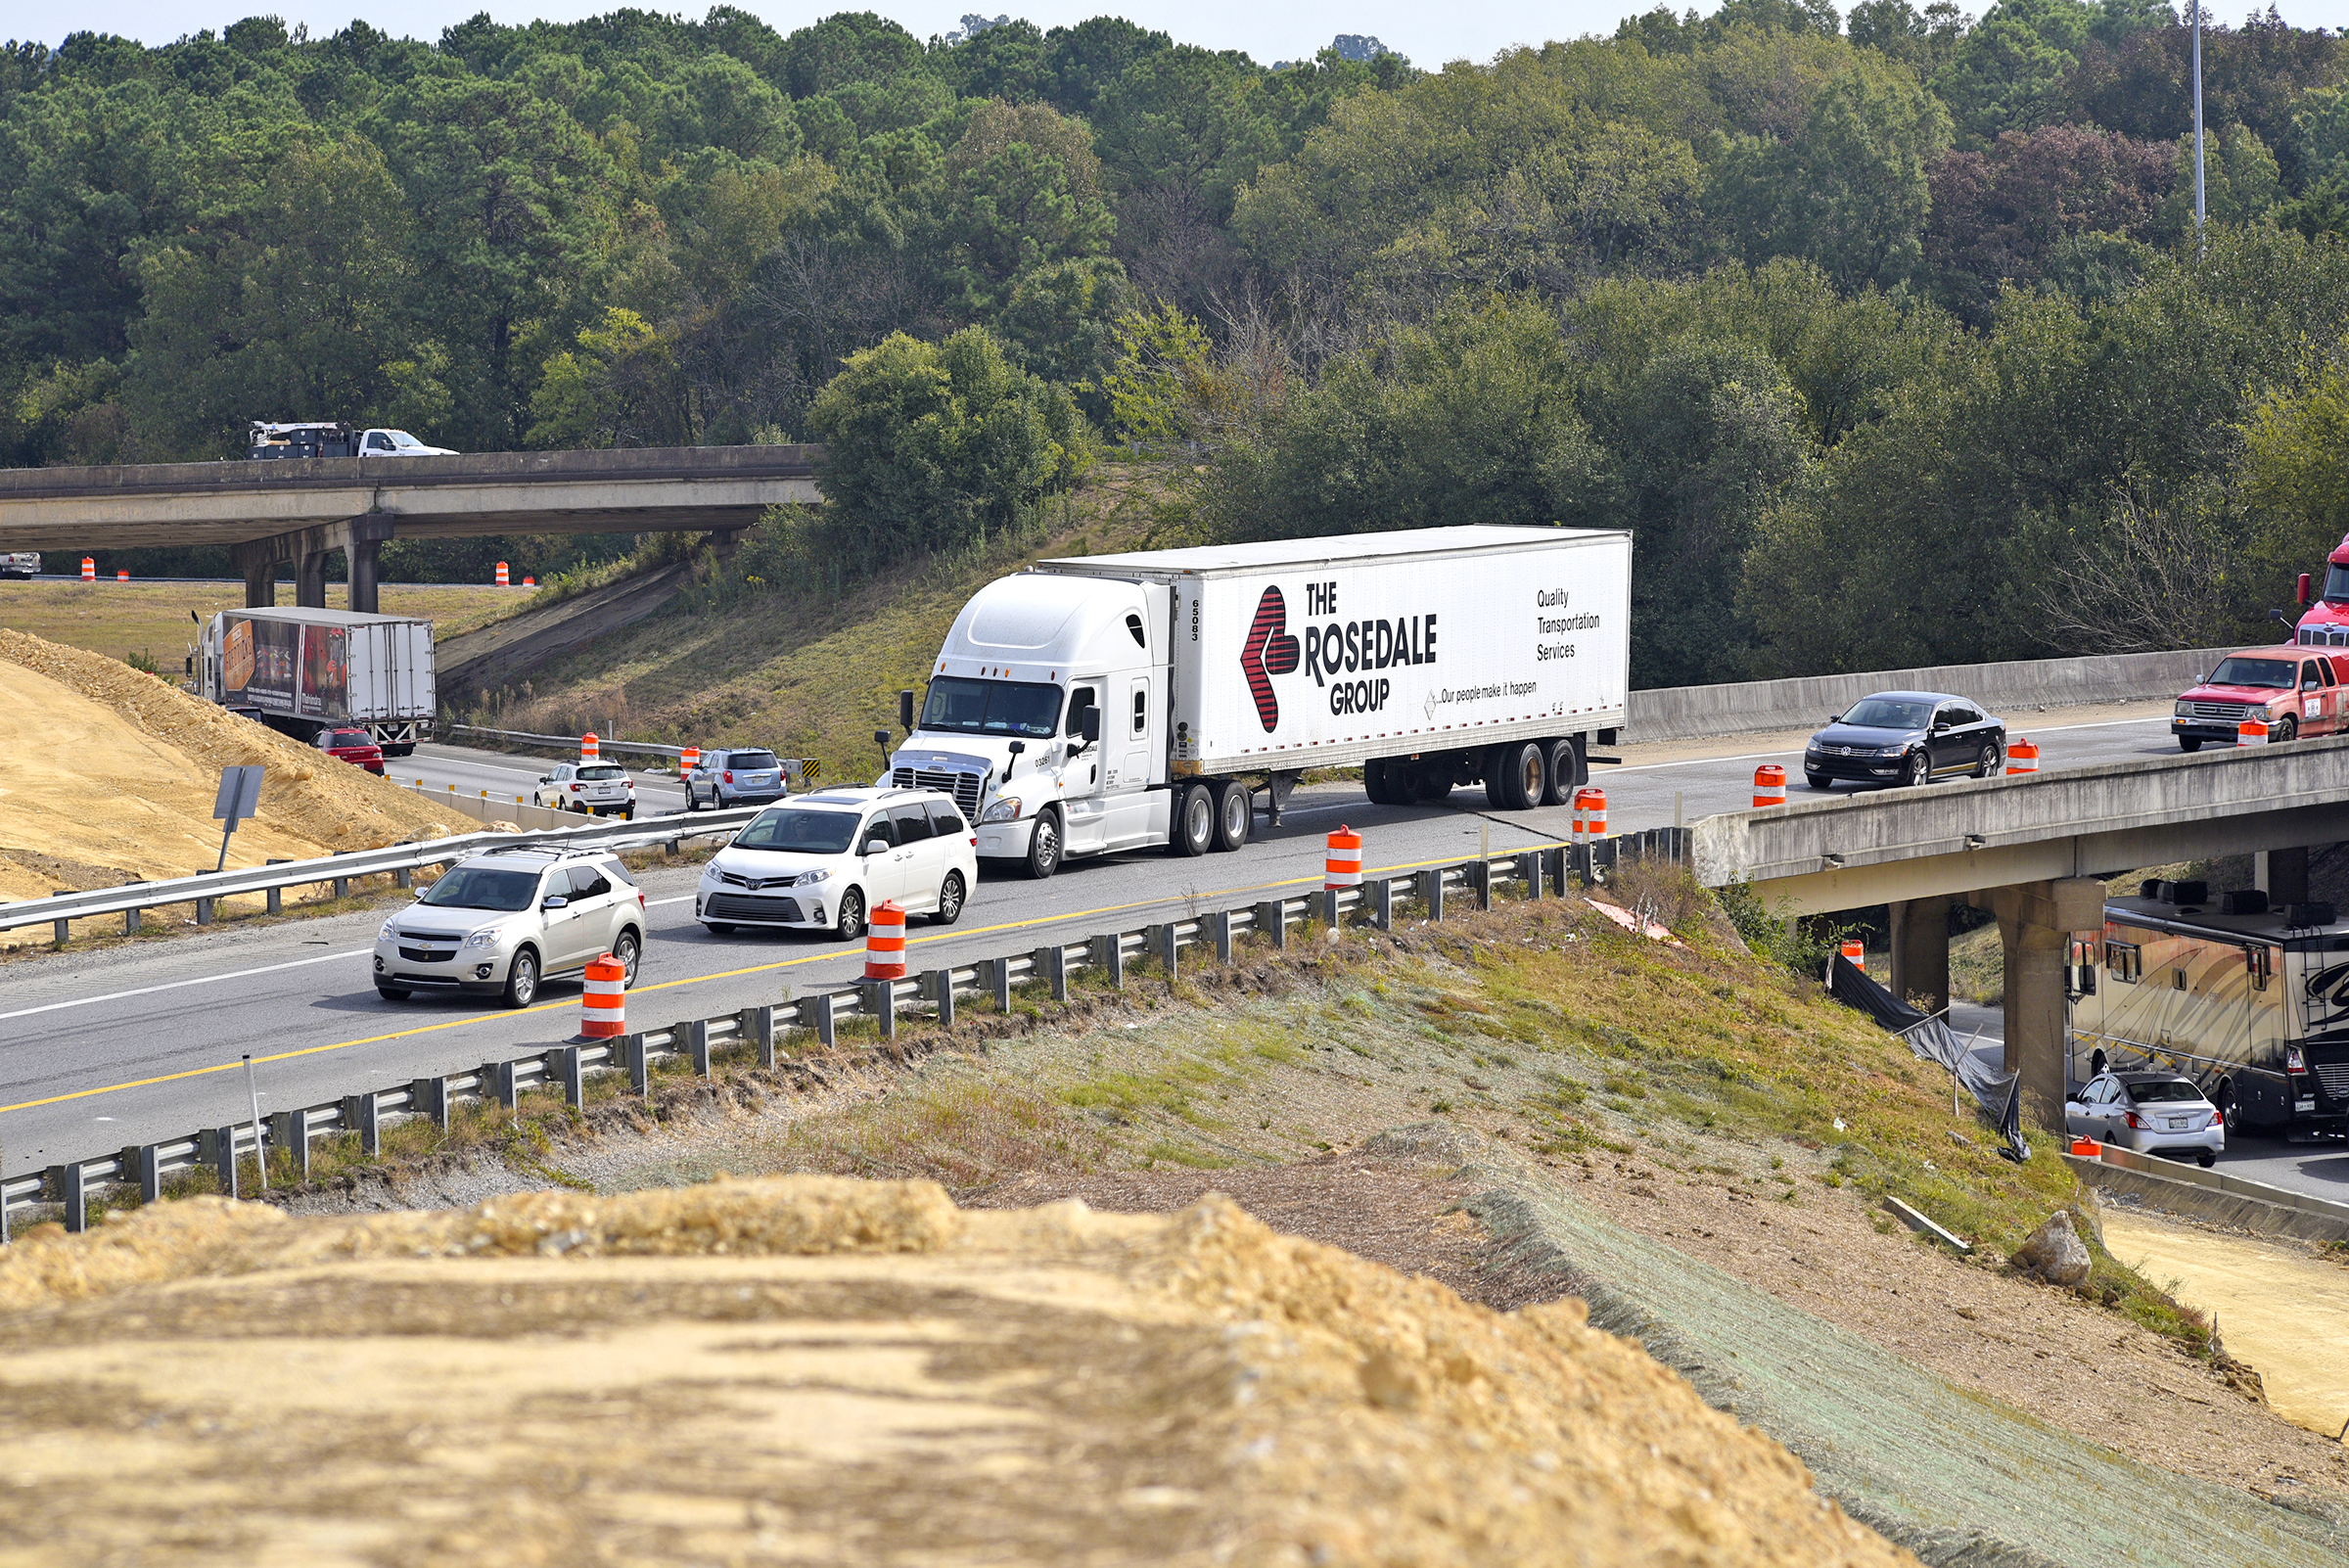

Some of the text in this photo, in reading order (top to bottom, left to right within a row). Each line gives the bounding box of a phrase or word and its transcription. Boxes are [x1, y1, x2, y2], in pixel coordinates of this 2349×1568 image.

[1307, 581, 1337, 617] THE
[1538, 587, 1568, 608] Quality
[1191, 599, 1200, 641] 65083
[1538, 612, 1600, 636] Transportation
[1306, 614, 1437, 687] ROSEDALE
[1538, 641, 1575, 661] Services
[1330, 677, 1391, 716] GROUP
[1456, 685, 1481, 705] people
[1481, 683, 1501, 699] make
[1502, 681, 1508, 697] it
[1510, 681, 1537, 698] happen
[1035, 756, 1050, 767] 03261
